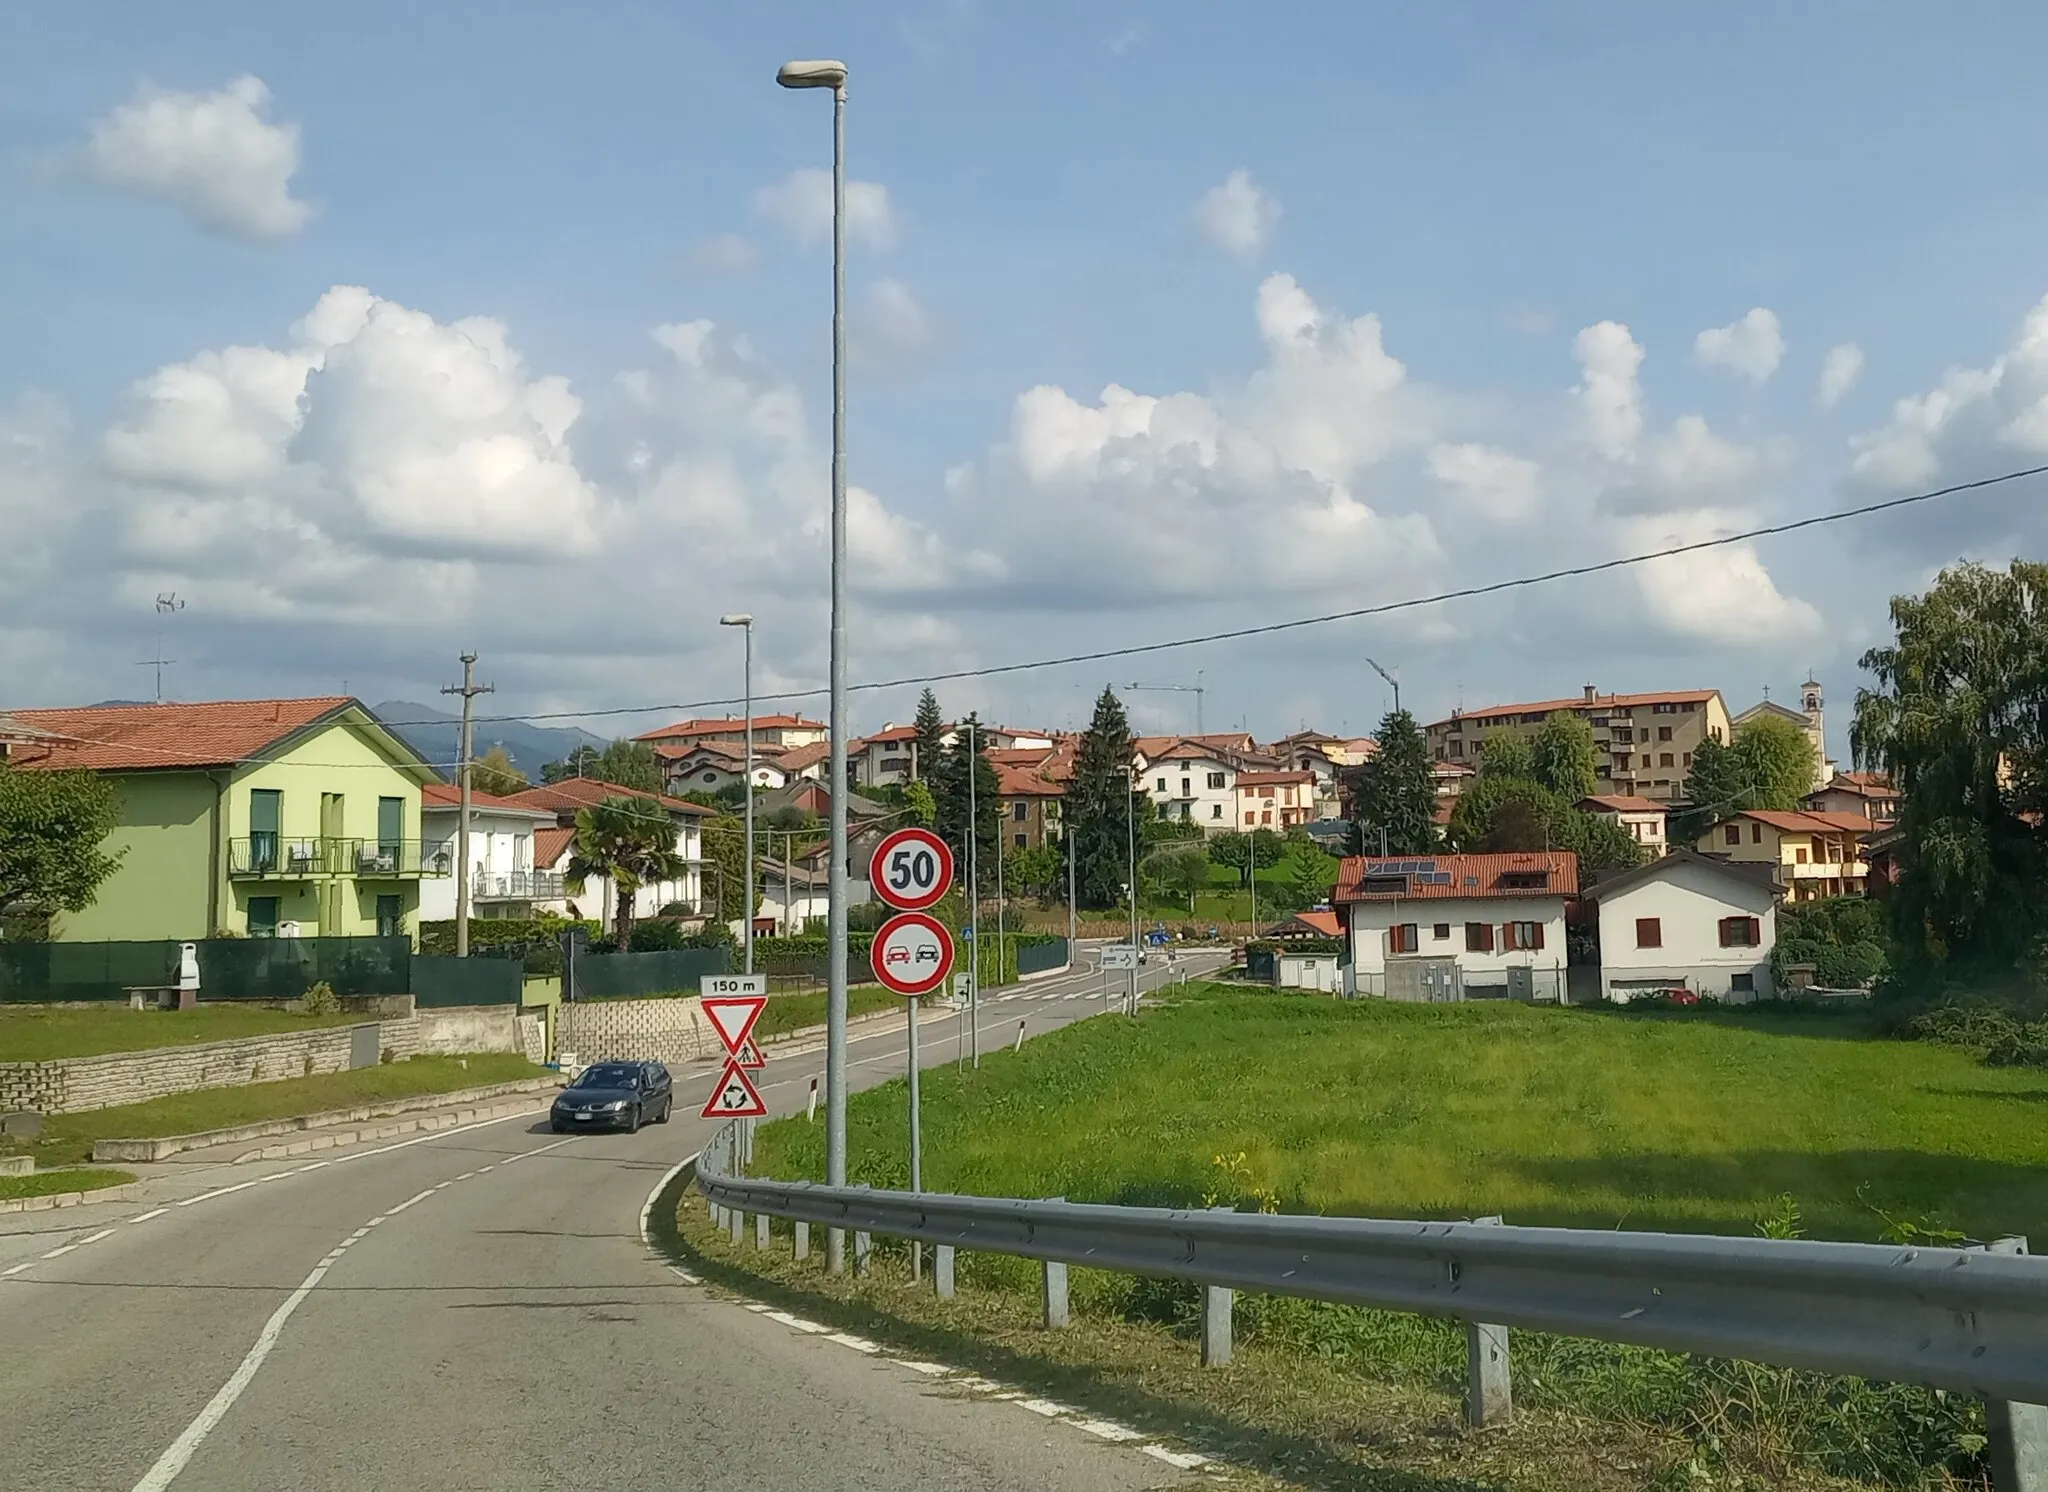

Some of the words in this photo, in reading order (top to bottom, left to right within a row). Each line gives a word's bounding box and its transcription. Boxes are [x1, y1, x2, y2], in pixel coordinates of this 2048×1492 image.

[890, 850, 935, 890] 50
[711, 980, 738, 992] 150
[742, 983, 756, 992] m
